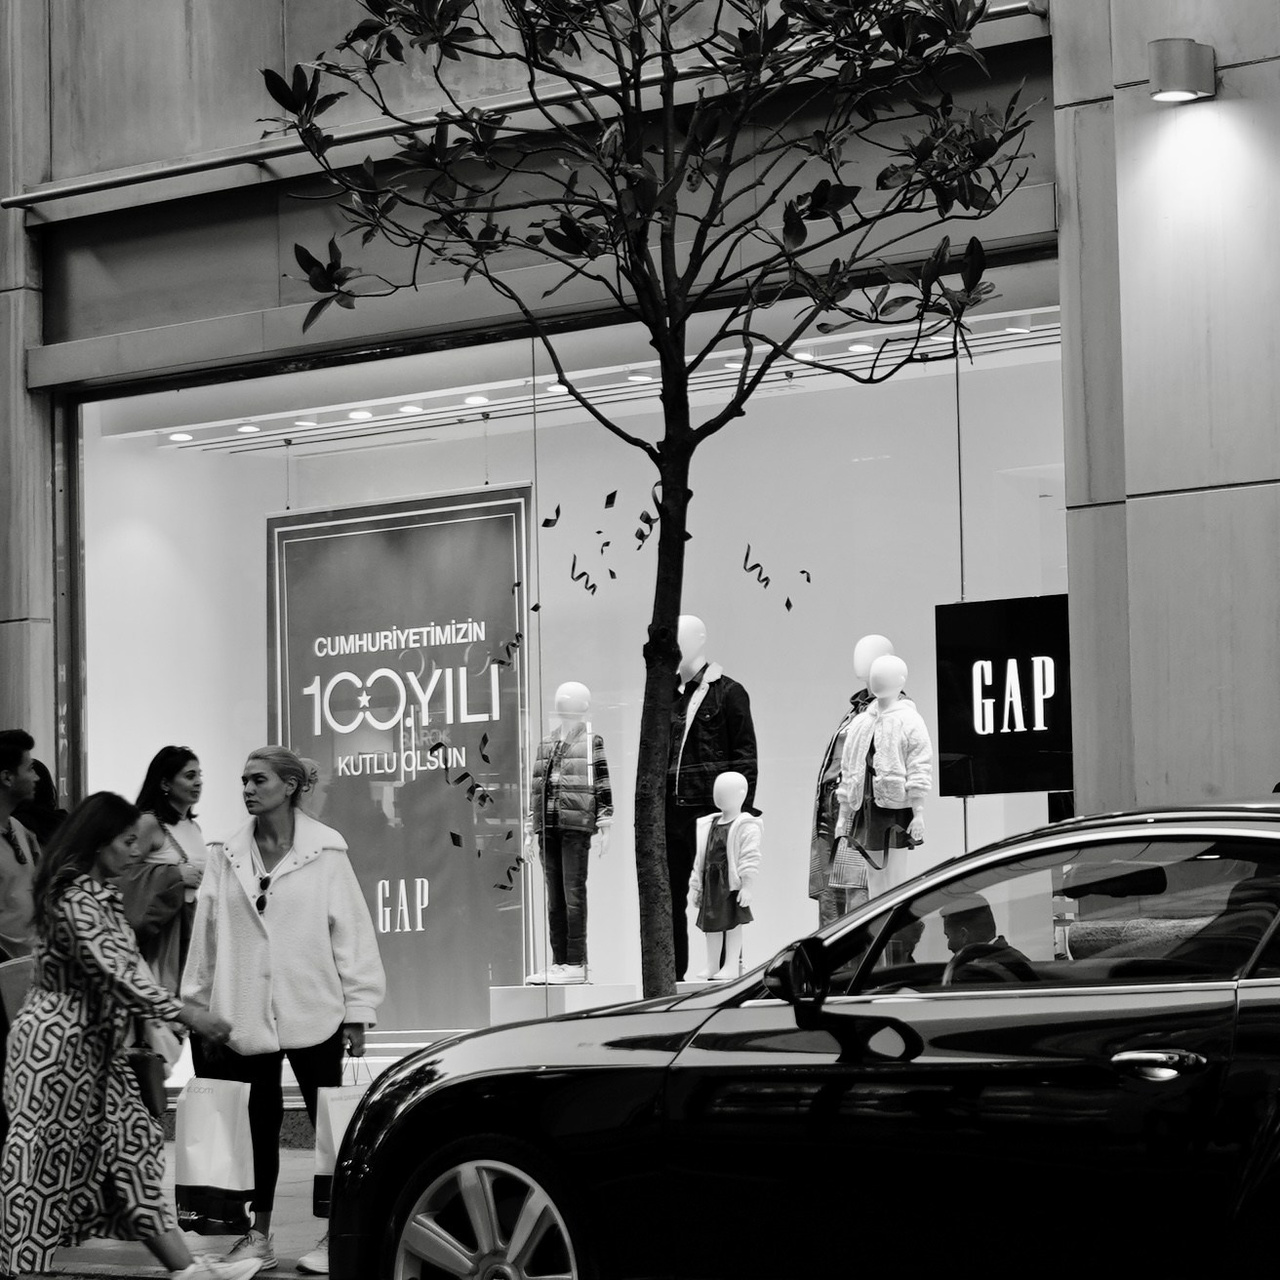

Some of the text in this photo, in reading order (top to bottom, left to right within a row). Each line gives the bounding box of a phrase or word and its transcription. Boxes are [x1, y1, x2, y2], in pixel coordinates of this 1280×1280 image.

[314, 618, 486, 657] CUMHURİYETİMİZİN
[972, 656, 1055, 735] GAP
[338, 747, 466, 776] KUTLU OLSUN
[378, 878, 429, 933] GAP
